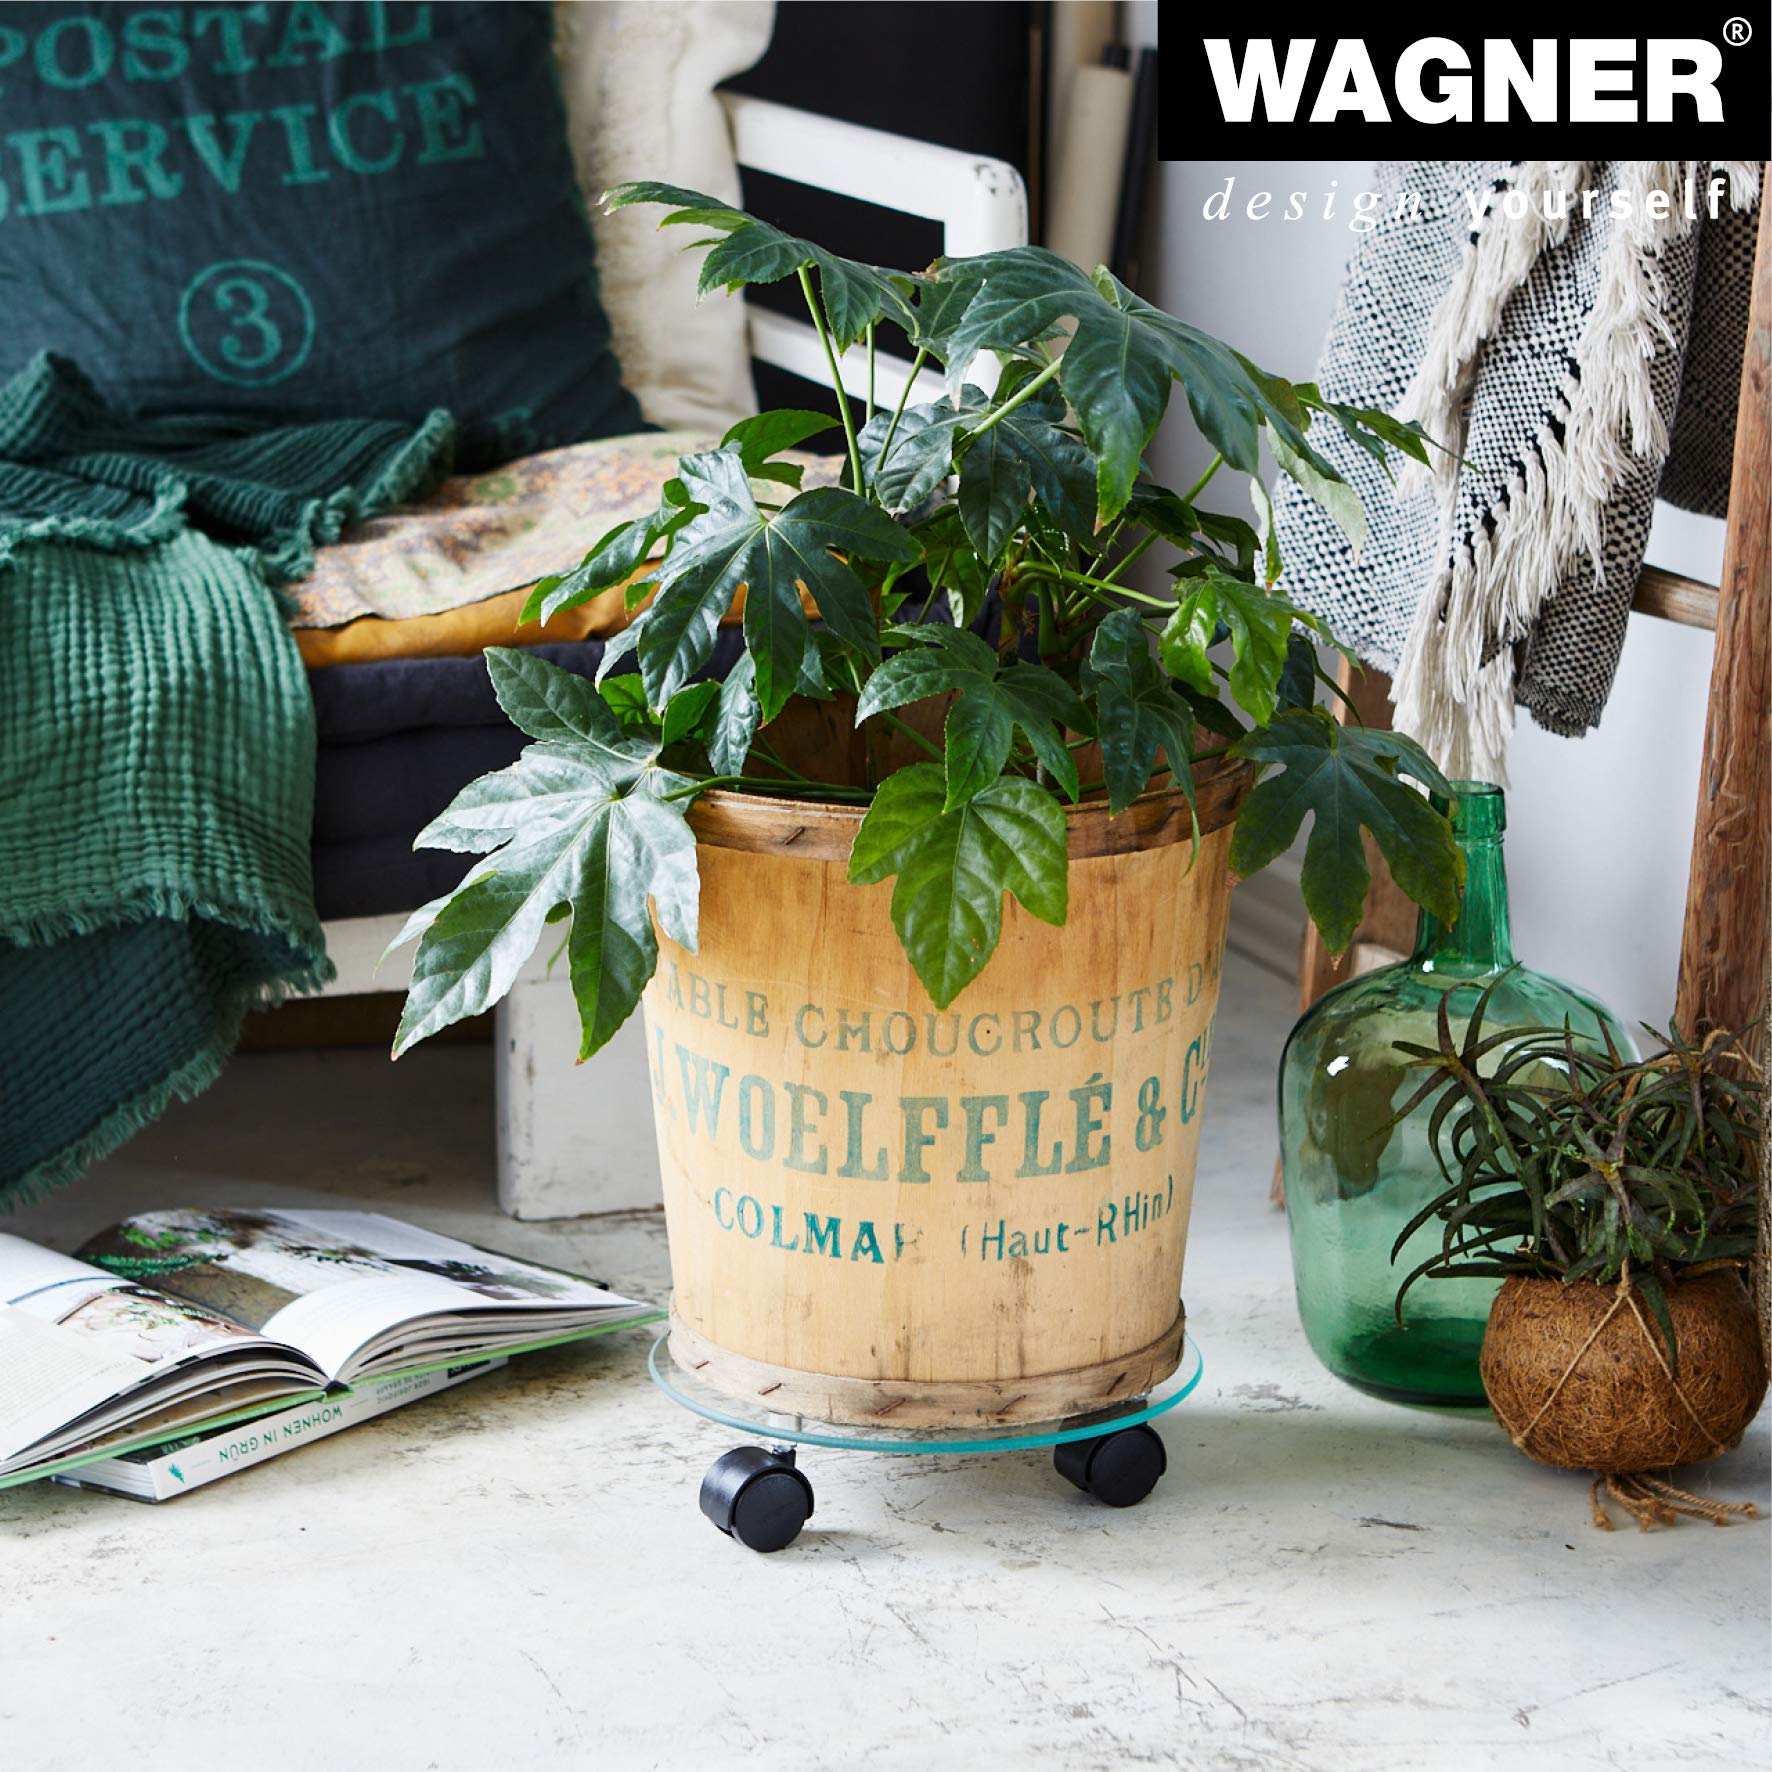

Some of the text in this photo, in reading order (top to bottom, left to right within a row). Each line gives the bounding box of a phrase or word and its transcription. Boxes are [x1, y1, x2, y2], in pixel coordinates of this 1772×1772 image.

[0, 73, 485, 224] ERVICE
[214, 278, 283, 369] 3
[1135, 1075, 1167, 1153] &
[219, 1405, 343, 1462] WOHNEN IN GRÜN
